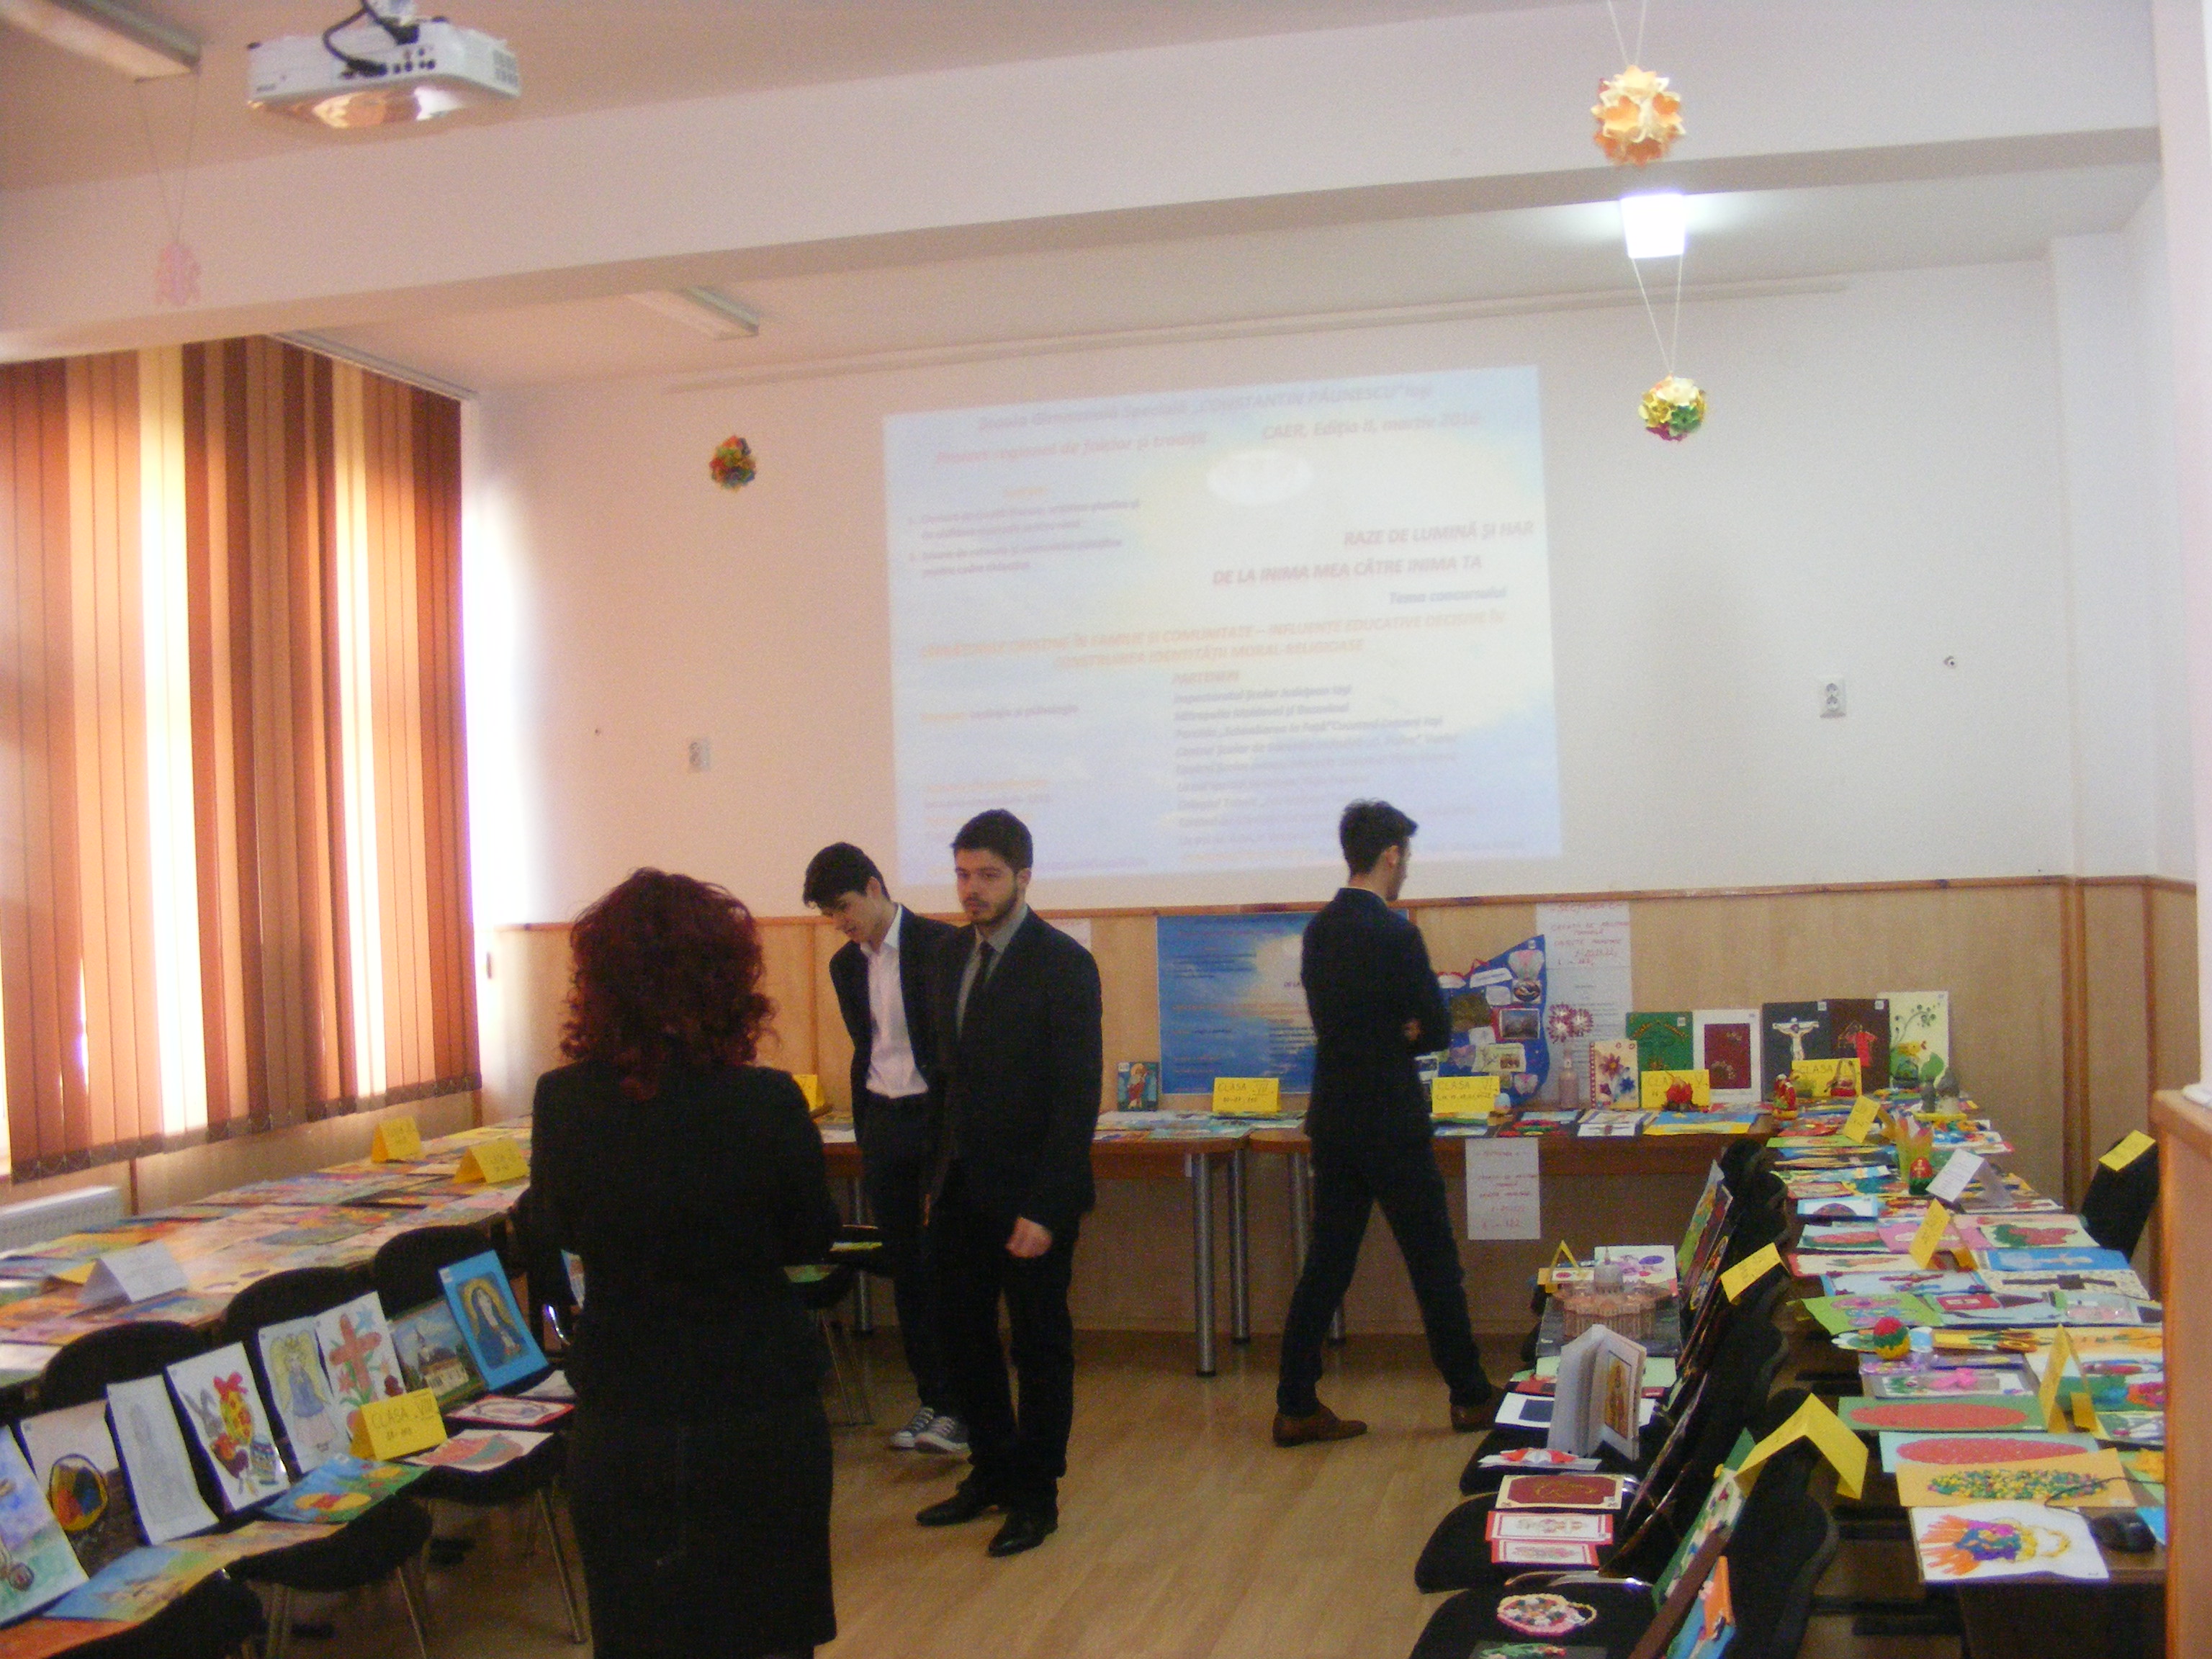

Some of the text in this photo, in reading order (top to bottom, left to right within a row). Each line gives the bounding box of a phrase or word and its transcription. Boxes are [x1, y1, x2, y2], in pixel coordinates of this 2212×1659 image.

[1343, 529, 1385, 548] RAZE
[1388, 527, 1411, 545] DE
[1412, 519, 1478, 544] LUMINĂ
[1499, 519, 1534, 537] HAR
[1212, 552, 1483, 585] DE LA INIMA MEA CĂTRE INIMA TA
[1218, 1082, 1247, 1092] CLASA
[1437, 1080, 1470, 1091] CLASA
[372, 1407, 408, 1429] CLASA
